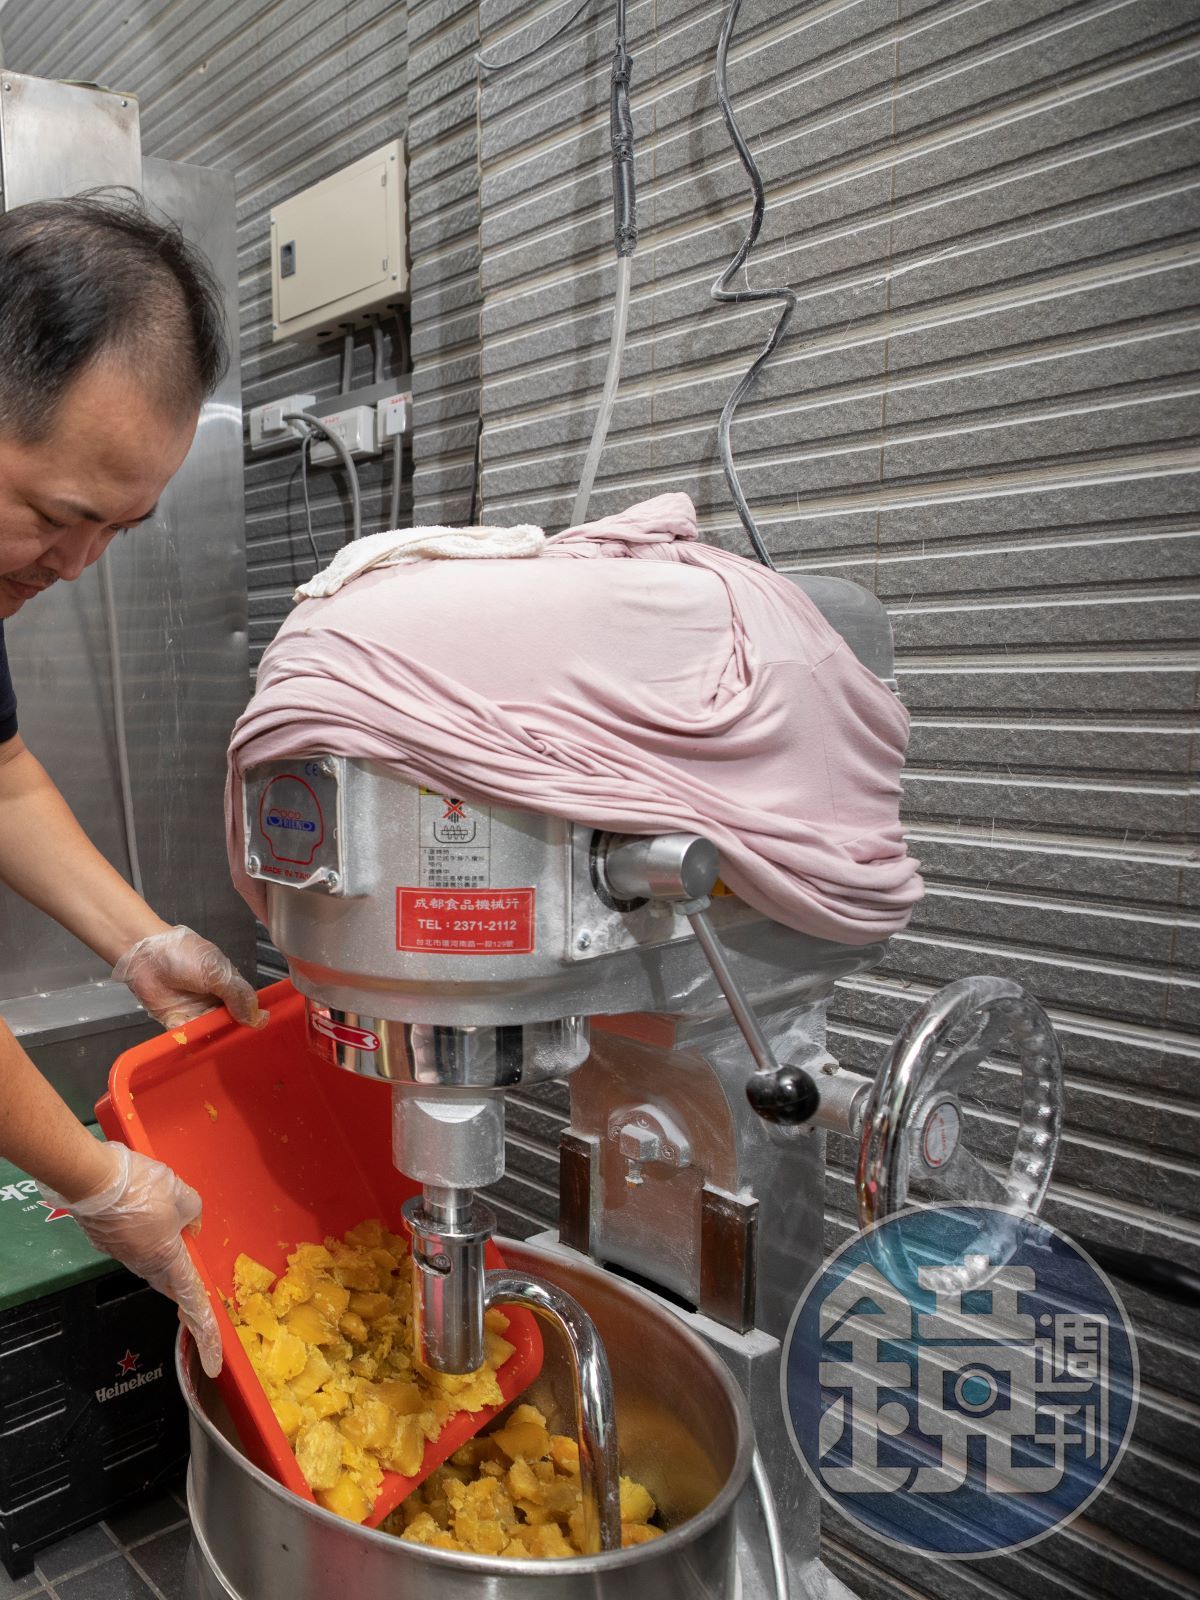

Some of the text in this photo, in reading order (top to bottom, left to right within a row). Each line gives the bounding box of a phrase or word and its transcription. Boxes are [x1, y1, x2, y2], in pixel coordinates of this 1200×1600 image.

[261, 864, 282, 875] MADE
[285, 869, 293, 877] IN
[414, 898, 519, 911] 成都食品機械行
[95, 1367, 163, 1403] Heineken
